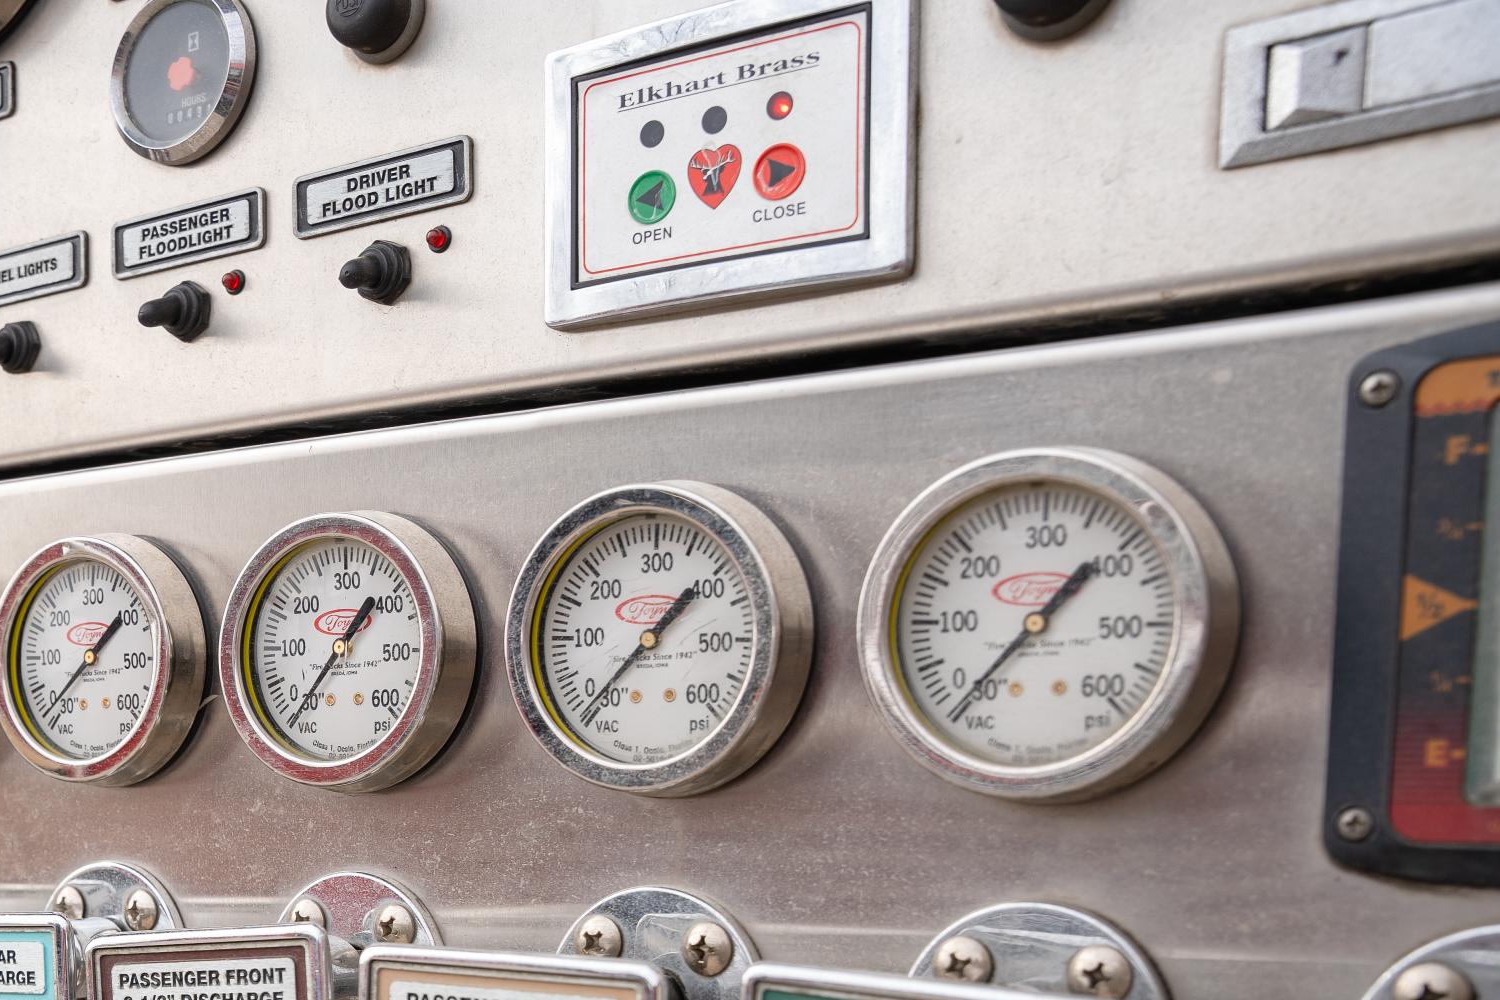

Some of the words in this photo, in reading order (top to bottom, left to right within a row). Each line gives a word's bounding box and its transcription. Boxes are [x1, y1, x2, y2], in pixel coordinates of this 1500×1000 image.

[618, 69, 725, 110] Elkhart
[736, 50, 821, 80] Brass
[346, 164, 410, 193] DRIVER
[322, 190, 379, 218] FLOOD
[385, 177, 438, 207] LIGHT
[752, 202, 806, 224] CLOSE
[141, 208, 231, 242] PASSENGER
[139, 225, 234, 259] FLOODLIGHT
[632, 226, 673, 246] OPEN
[17, 257, 57, 281] LIGHTS
[1025, 525, 1067, 549] 300
[641, 552, 673, 573] 300
[960, 555, 1001, 579] 200
[1092, 554, 1133, 577] 400
[334, 572, 360, 590] 300
[590, 579, 621, 600] 200
[692, 579, 724, 599] 400
[82, 588, 104, 605] 300
[293, 595, 319, 615] 200
[376, 595, 403, 614] 400
[50, 610, 70, 627] 200
[118, 609, 138, 625] 400
[940, 611, 978, 632] 100
[1099, 616, 1143, 639] 500
[574, 628, 604, 647] 100
[699, 632, 732, 653] 500
[41, 649, 61, 665] 100
[282, 638, 306, 657] 100
[382, 643, 410, 662] 500
[123, 652, 146, 669] 500
[585, 678, 595, 697] 0
[953, 668, 966, 689] 0
[1082, 675, 1124, 698] 600
[50, 691, 56, 706] 0
[117, 694, 139, 710] 600
[289, 684, 298, 702] 0
[371, 689, 399, 708] 600
[686, 684, 719, 704] 600
[60, 697, 79, 713] 30"
[58, 724, 73, 734] VAC
[120, 719, 133, 734] psi
[298, 721, 317, 733] VAC
[374, 718, 391, 734] psi
[596, 720, 619, 733] VAC
[690, 717, 709, 734] psi
[965, 715, 995, 730] VAC
[1085, 714, 1111, 731] psi
[1425, 739, 1449, 768] E
[119, 970, 220, 989] PASSENGER
[226, 967, 286, 986] FRONT
